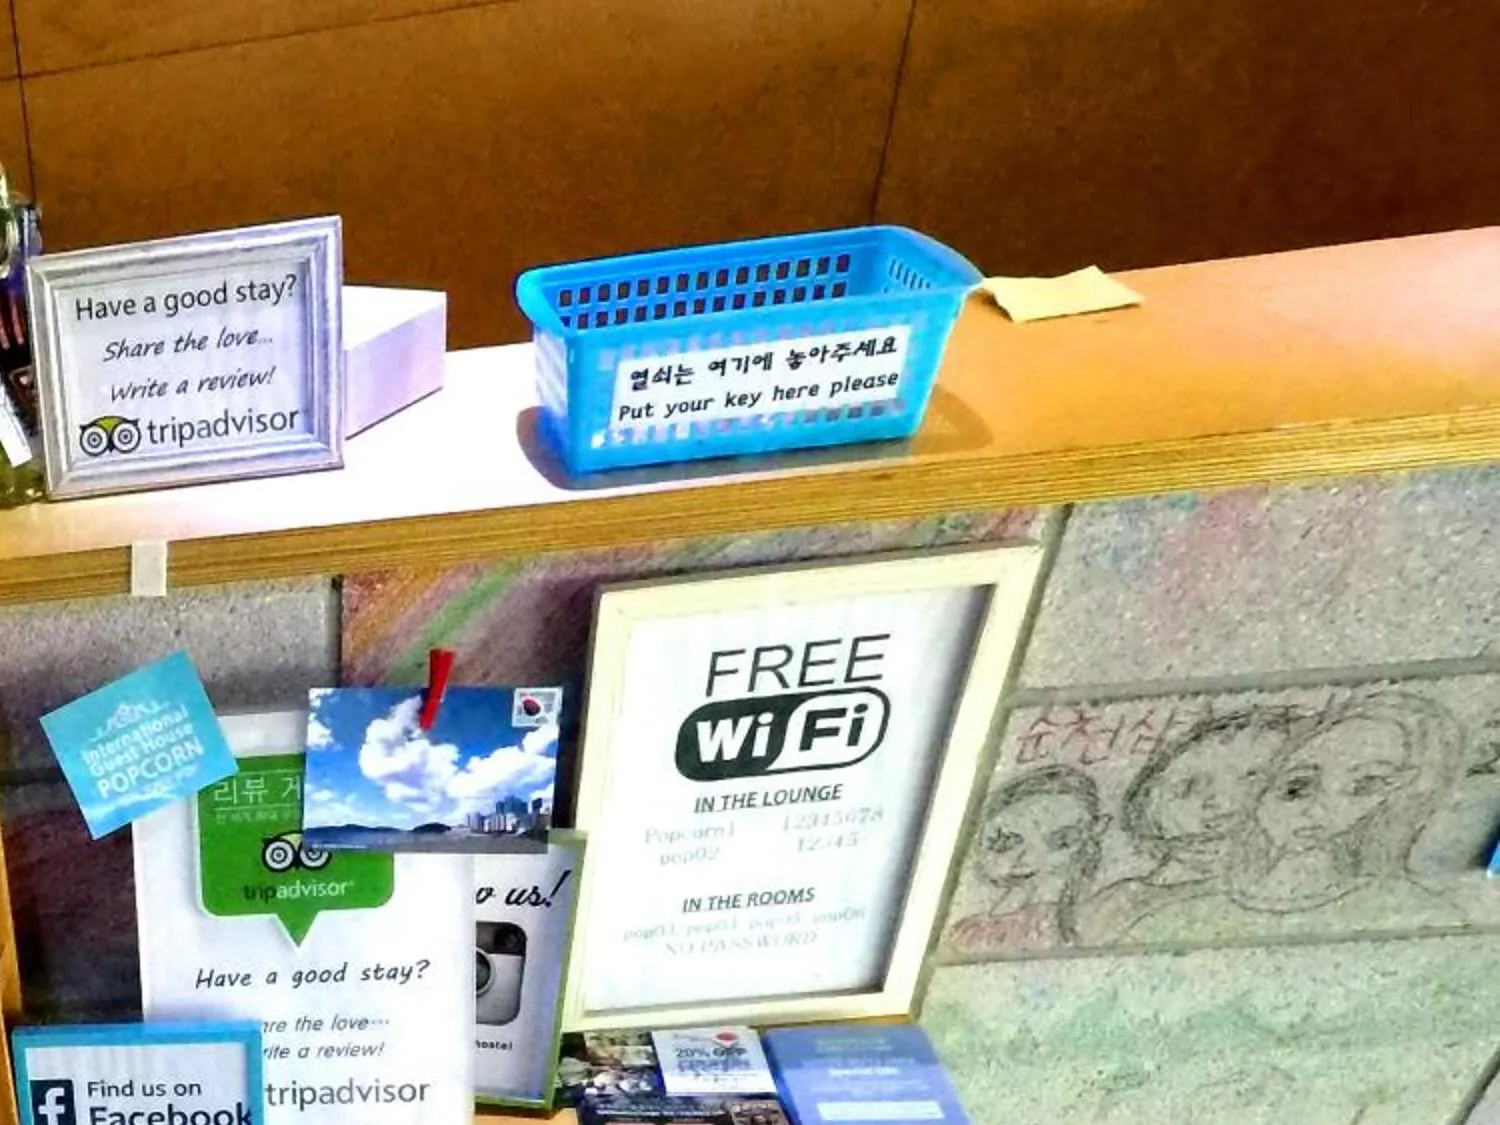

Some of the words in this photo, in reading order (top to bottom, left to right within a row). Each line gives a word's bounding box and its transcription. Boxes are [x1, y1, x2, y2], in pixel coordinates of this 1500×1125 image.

[76, 296, 136, 321] Have
[143, 297, 157, 313] a
[164, 280, 228, 319] good
[235, 273, 297, 307] stay?
[103, 338, 165, 363] Share
[174, 331, 209, 354] the
[630, 364, 695, 391] 열쇠는
[707, 351, 773, 376] 여기에
[785, 335, 898, 370] 놓아주세요
[111, 377, 169, 403] Write
[175, 380, 188, 395] a
[197, 365, 277, 392] review!
[618, 403, 654, 421] Put
[663, 397, 715, 418] your
[724, 389, 761, 412] key
[773, 381, 820, 402] here
[830, 371, 899, 399] please
[147, 407, 301, 449] tripadvisor
[705, 633, 891, 698] FREE
[82, 704, 189, 765] International
[89, 746, 141, 778] Guest
[144, 723, 194, 751] House
[97, 740, 205, 798] POPCORN
[214, 776, 268, 804] 리뷰
[693, 796, 714, 814] IN
[721, 791, 757, 811] THE
[762, 784, 843, 808] LOUNGE
[244, 879, 350, 902] tripadvisor
[505, 870, 572, 907] us!
[682, 896, 702, 913] IN
[707, 893, 742, 911] THE
[746, 886, 815, 907] ROOMS
[196, 968, 252, 988] Have
[266, 971, 278, 985] a
[292, 962, 348, 985] good
[361, 960, 430, 981] stay?
[295, 1015, 324, 1032] the
[298, 1046, 310, 1059] a
[317, 1041, 386, 1059] review!
[87, 1079, 135, 1098] Find
[141, 1082, 167, 1096] us
[174, 1081, 202, 1095] on
[265, 1075, 431, 1112] tripadvisor
